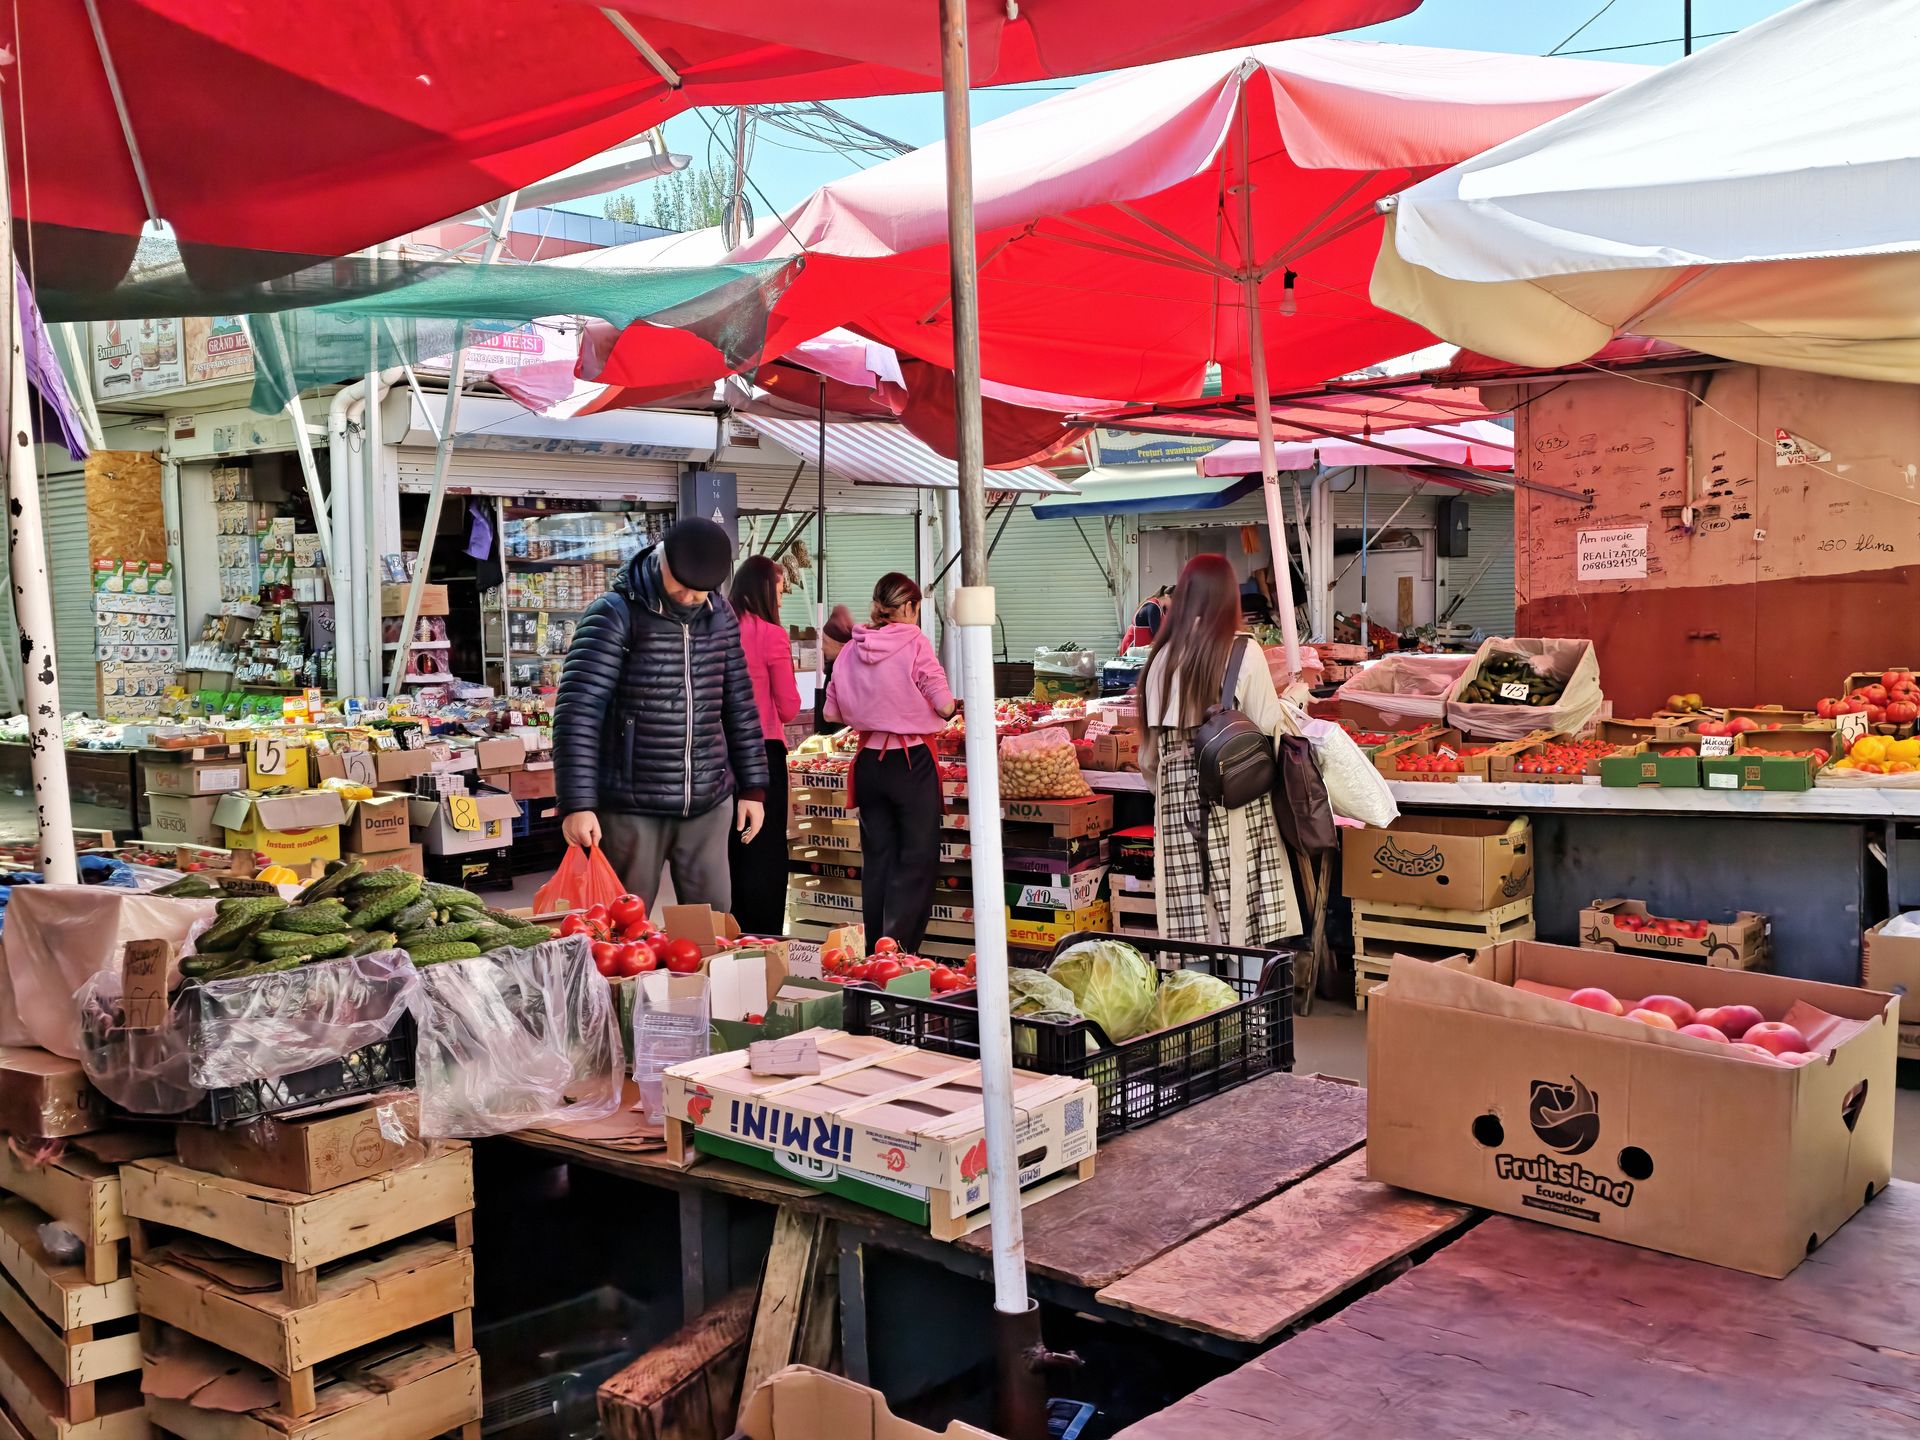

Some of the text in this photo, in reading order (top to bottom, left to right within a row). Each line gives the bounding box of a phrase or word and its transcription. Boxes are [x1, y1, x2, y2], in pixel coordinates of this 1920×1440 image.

[208, 336, 233, 352] GRAND
[503, 335, 537, 351] MERSI
[1126, 533, 1138, 545] 19
[1580, 532, 1635, 545] Am nevoie
[1817, 539, 1847, 551] 260
[1504, 685, 1527, 698] 45
[259, 740, 280, 773] 5
[156, 817, 187, 833] ROSHEN
[365, 815, 404, 830] Damla
[266, 834, 328, 849] Instant noodles
[1376, 846, 1443, 876] BanaBay
[1025, 888, 1050, 903] SAD
[1010, 928, 1056, 942] semirs
[1635, 933, 1684, 948] UNIQUE
[1495, 1154, 1634, 1207] Fruitsland
[1536, 1184, 1586, 1205] Ecuador
